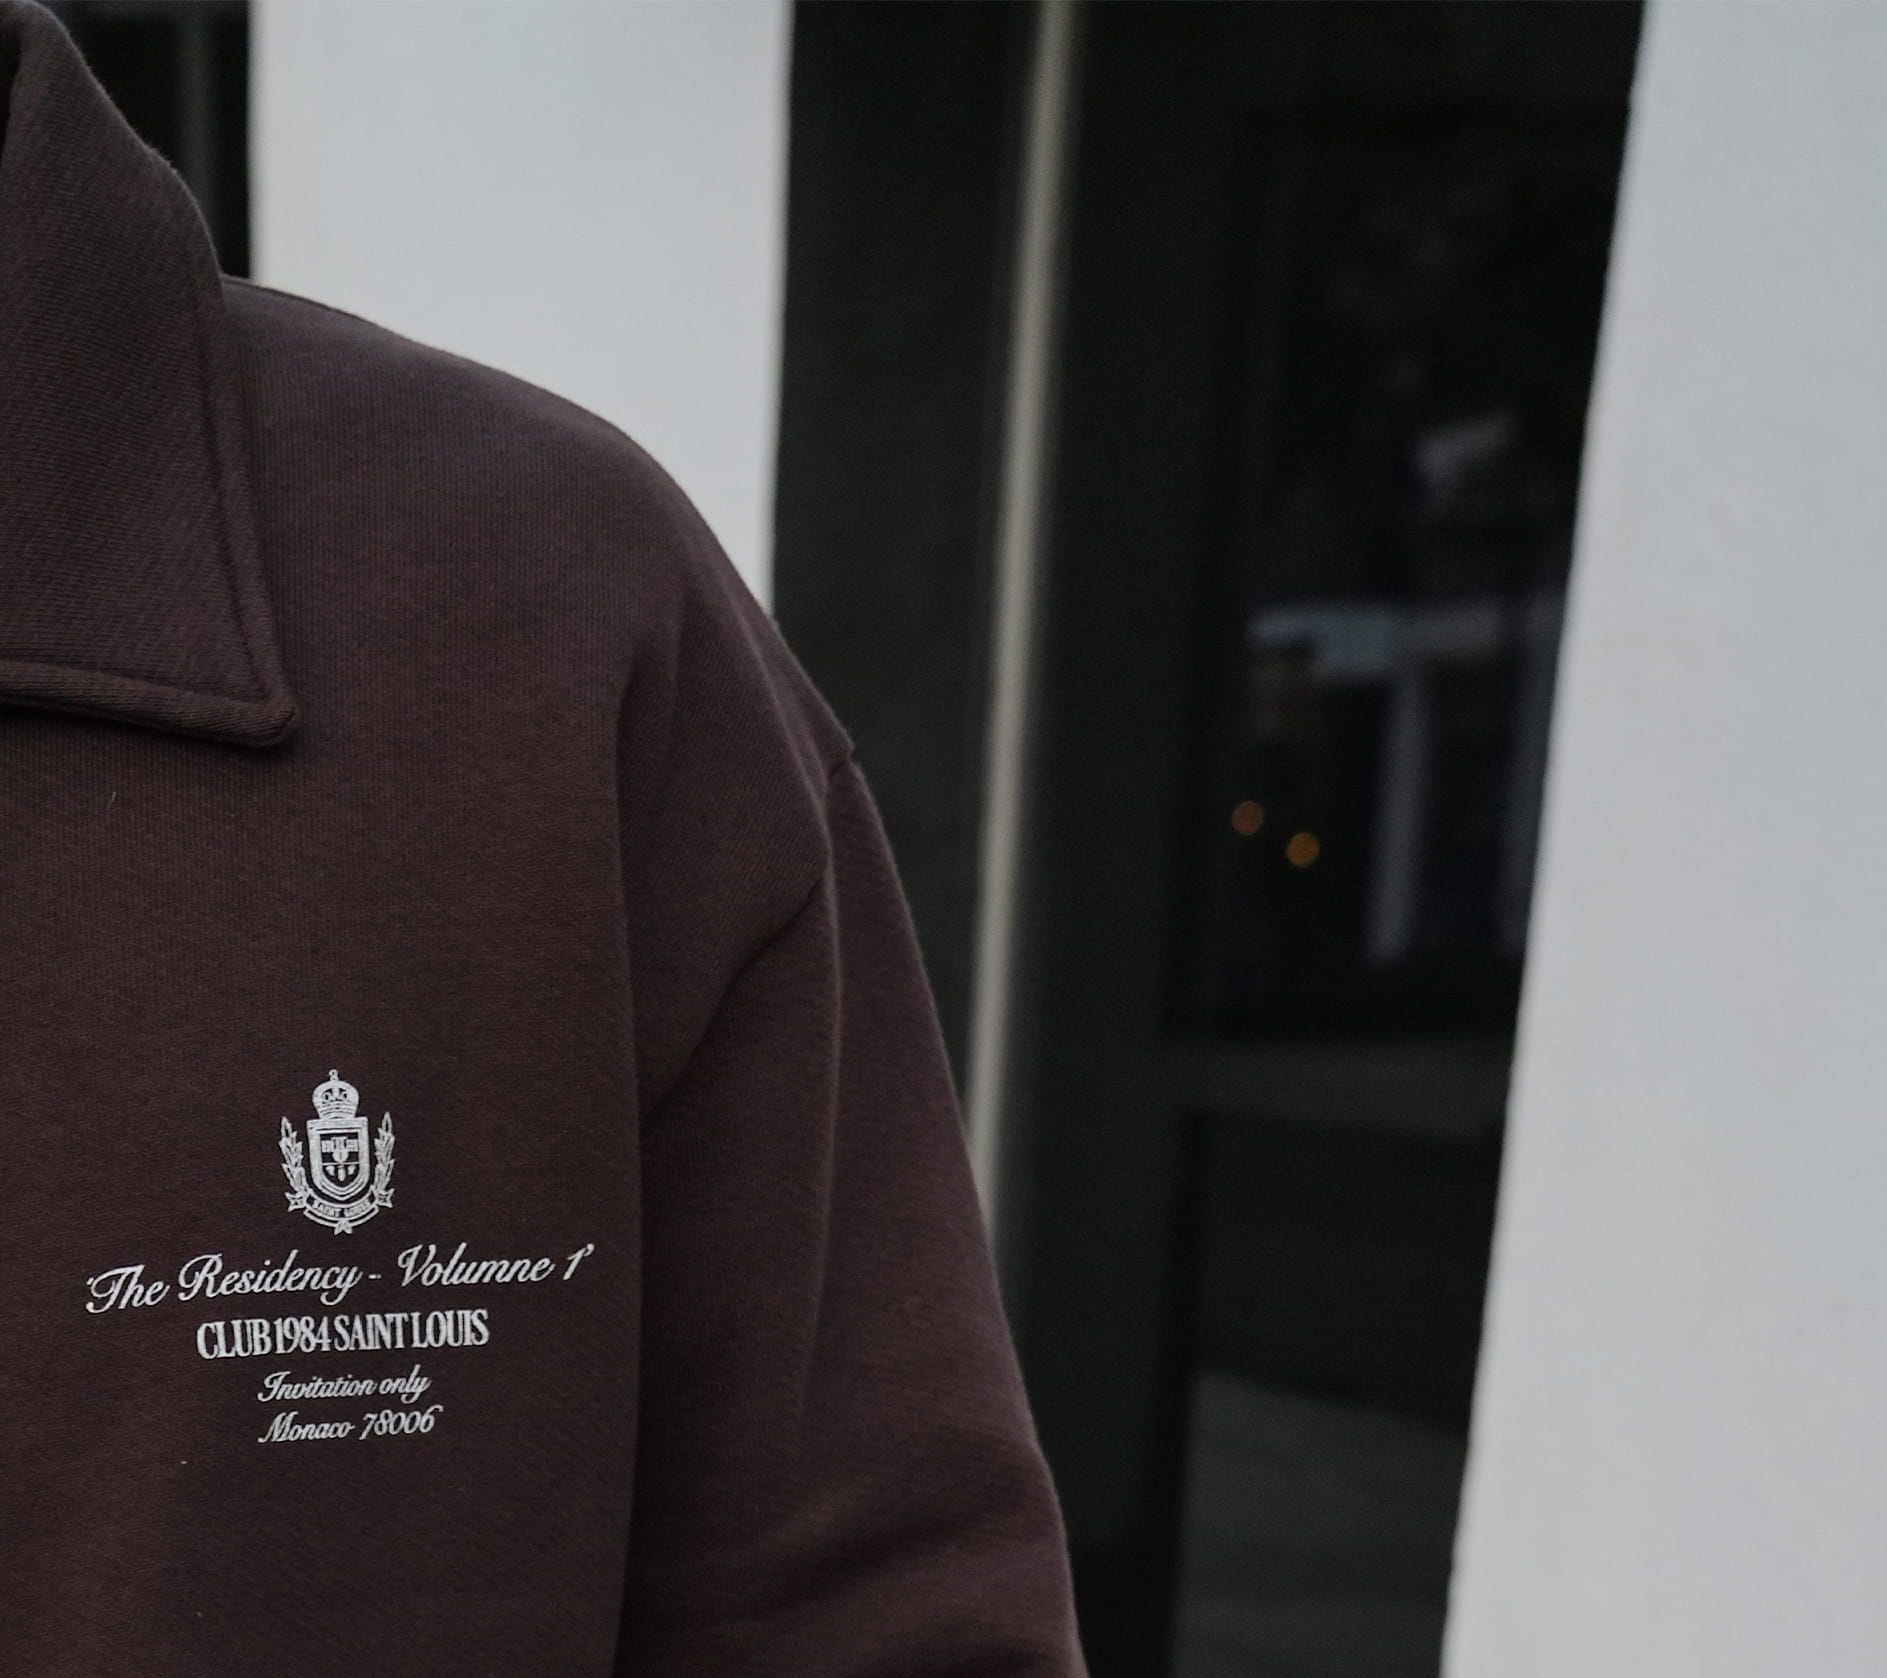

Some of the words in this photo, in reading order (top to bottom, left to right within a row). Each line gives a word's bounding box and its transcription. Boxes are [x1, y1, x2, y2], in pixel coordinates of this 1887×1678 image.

[178, 1248, 362, 1306] Residency
[398, 1242, 556, 1288] Volumne
[196, 1315, 274, 1360] CLUB
[274, 1312, 332, 1354] 1984
[335, 1311, 408, 1353] SAINT
[411, 1308, 489, 1348] LOUIS
[257, 1370, 376, 1403] Invitation
[379, 1363, 430, 1404] only
[258, 1411, 355, 1444] Monaco
[359, 1405, 444, 1440] 78006
